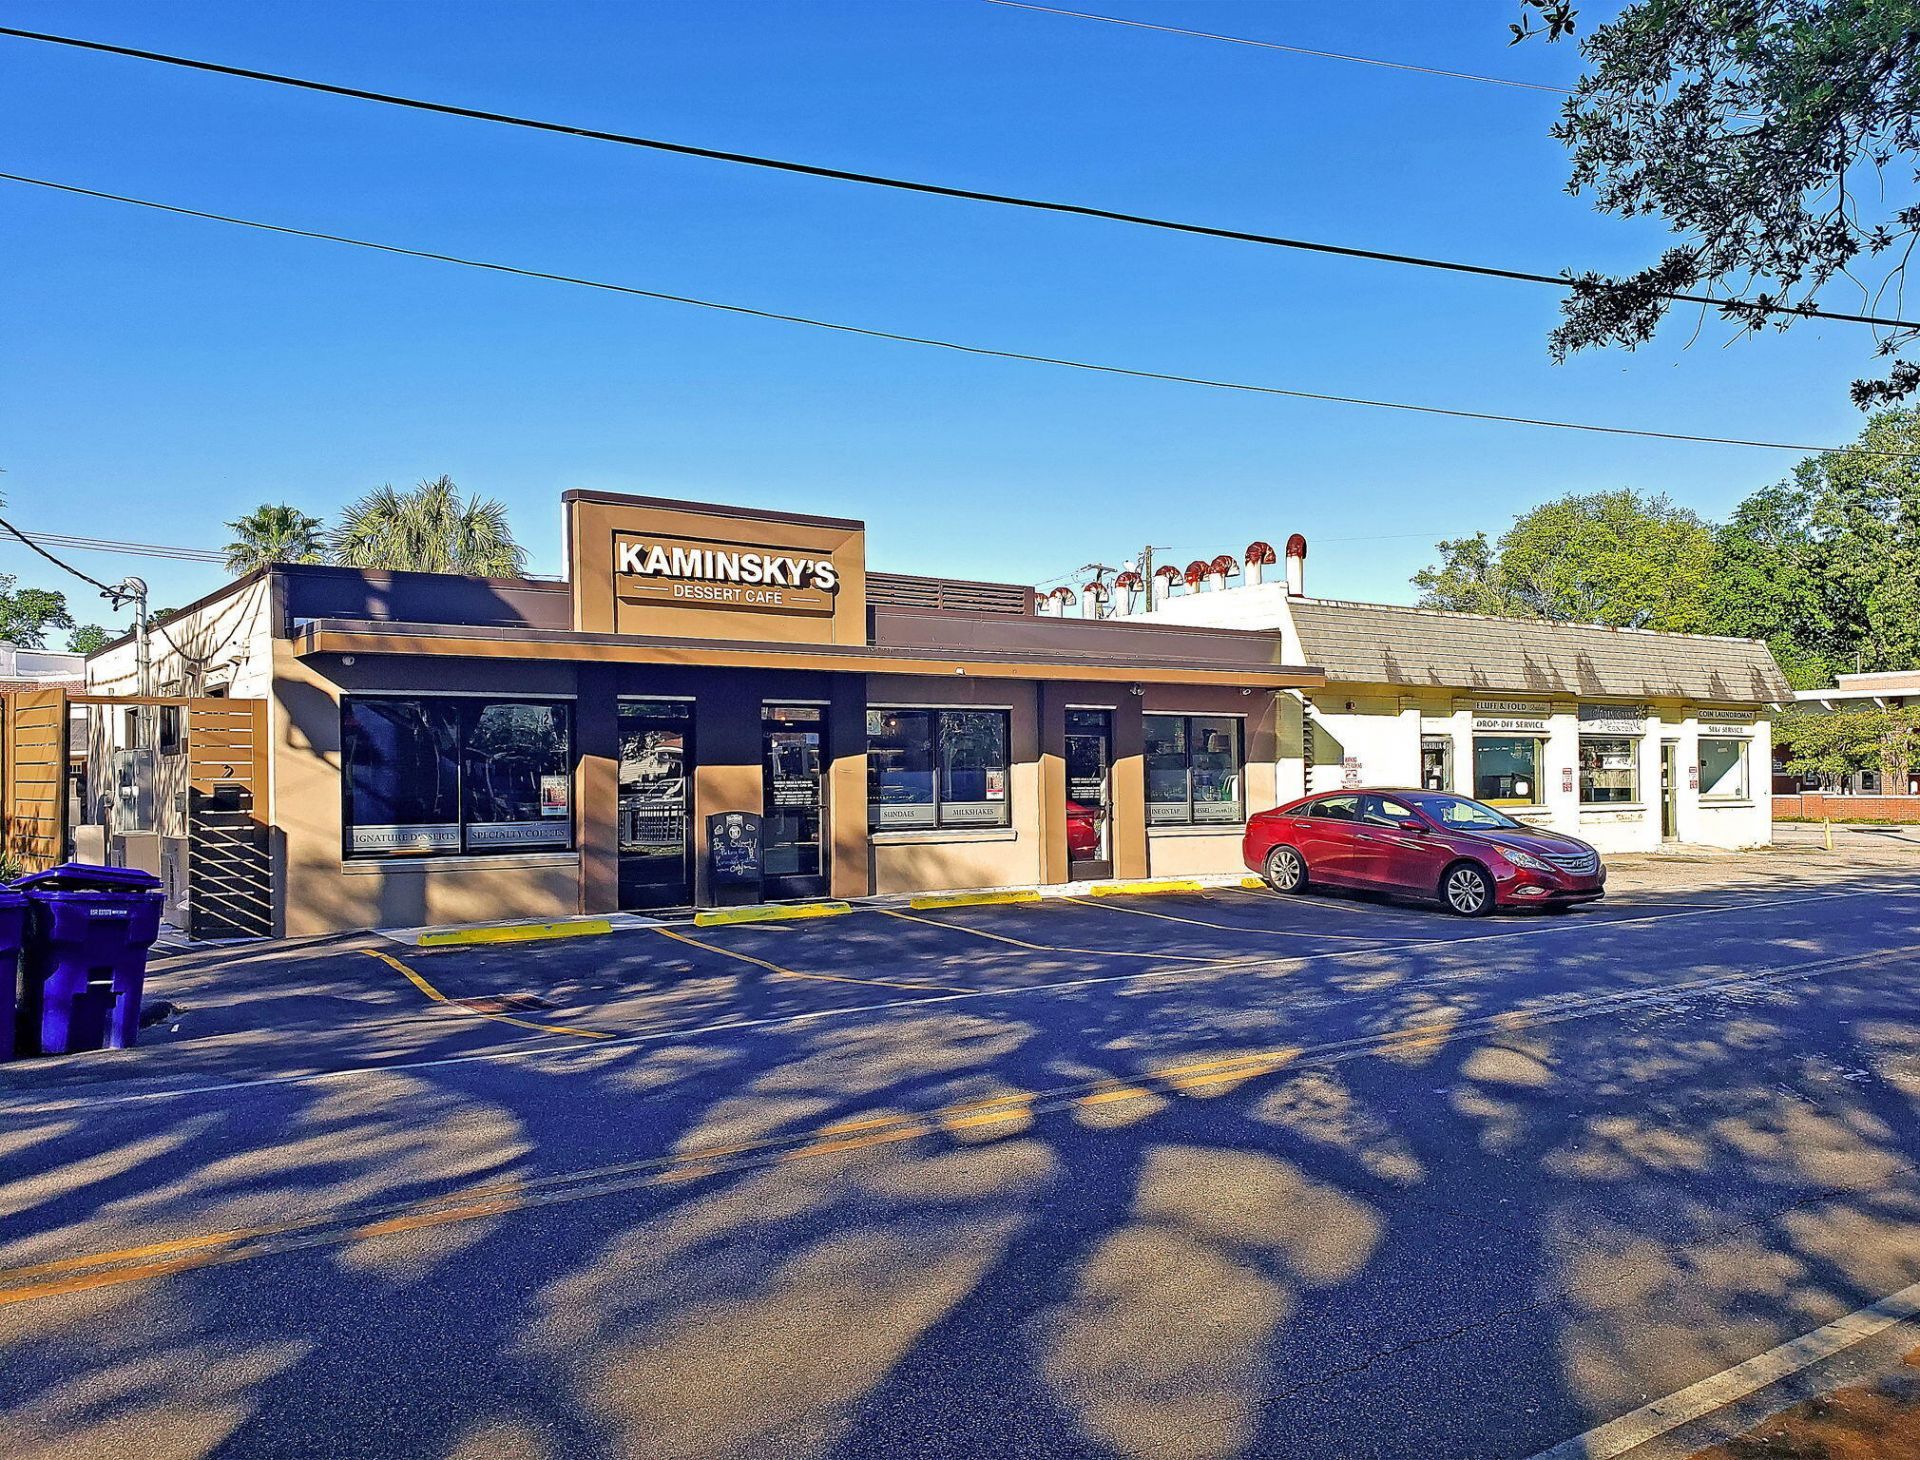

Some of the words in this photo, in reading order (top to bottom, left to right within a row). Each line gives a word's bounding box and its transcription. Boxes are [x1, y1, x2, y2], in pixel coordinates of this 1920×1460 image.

[619, 542, 836, 589] KAMINSKY'S
[673, 584, 742, 602] DESSERT
[745, 589, 783, 605] CAFÉ
[1476, 702, 1498, 710] FLUFF
[1698, 710, 1714, 718] COIN
[1515, 721, 1545, 729] SERVICE
[883, 810, 915, 818] SUNDAES
[353, 833, 409, 843] IGNATURE
